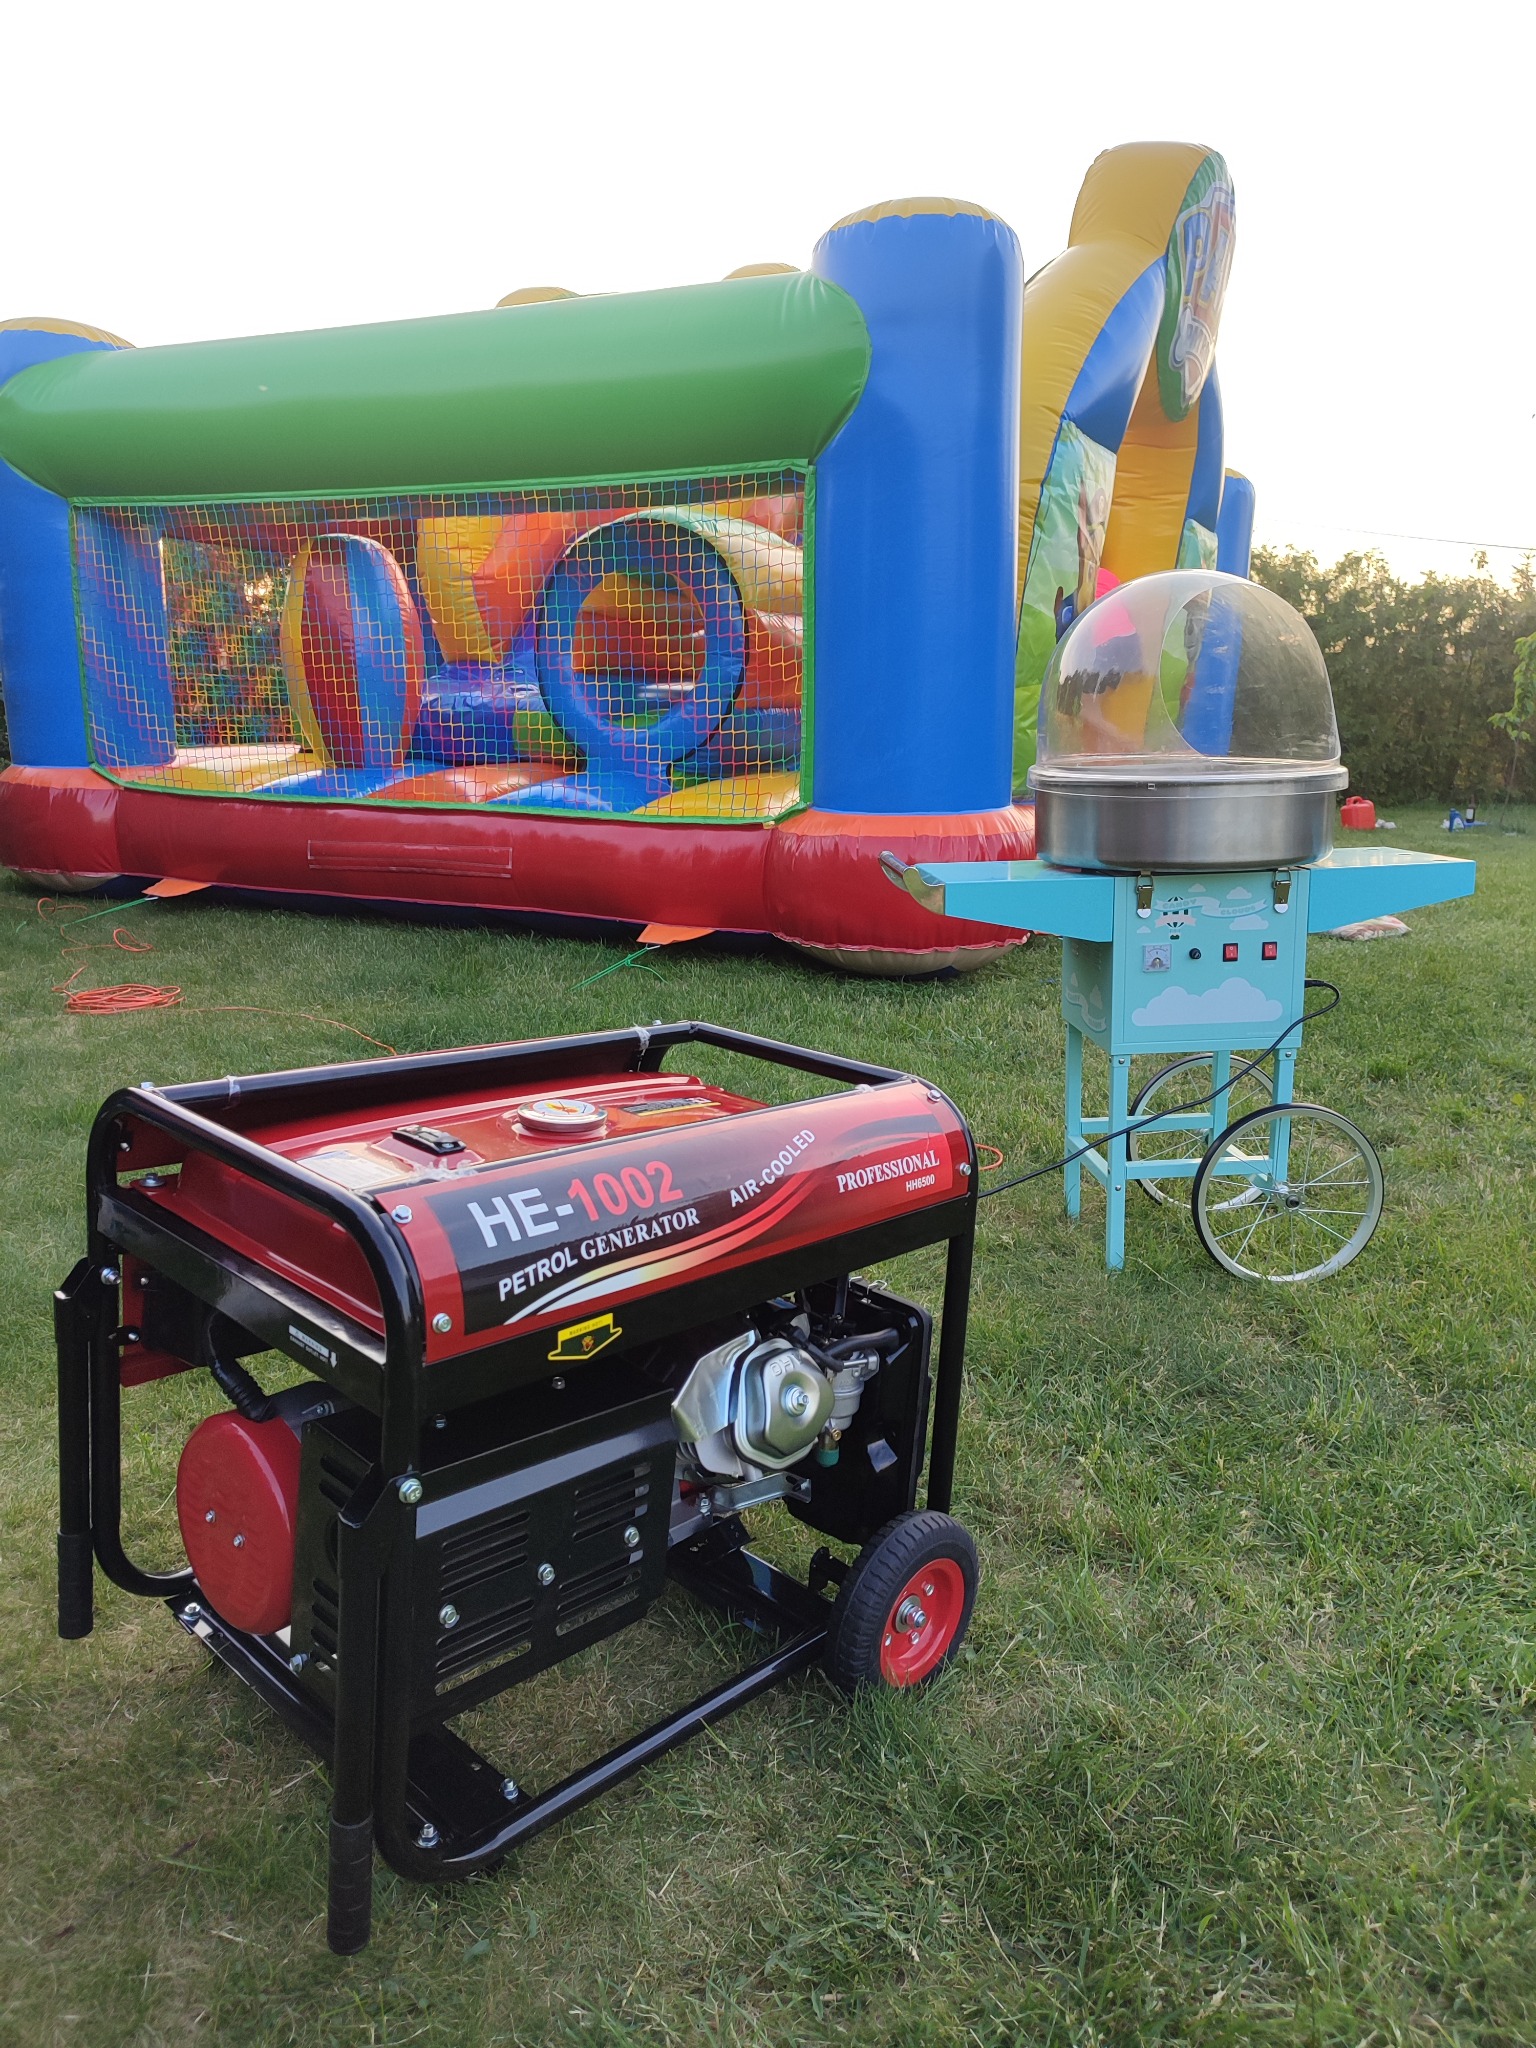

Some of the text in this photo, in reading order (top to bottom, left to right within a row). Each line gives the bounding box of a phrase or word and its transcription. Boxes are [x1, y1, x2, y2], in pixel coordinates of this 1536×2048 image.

[1162, 898, 1256, 916] CANDY CLOUDS
[729, 1129, 816, 1208] AIR-COOLED
[835, 1149, 940, 1194] PROFESSIONAL
[905, 1173, 936, 1193] HH6500
[466, 1160, 684, 1249] HE-1002
[498, 1207, 701, 1302] PETROL GENERATOR
